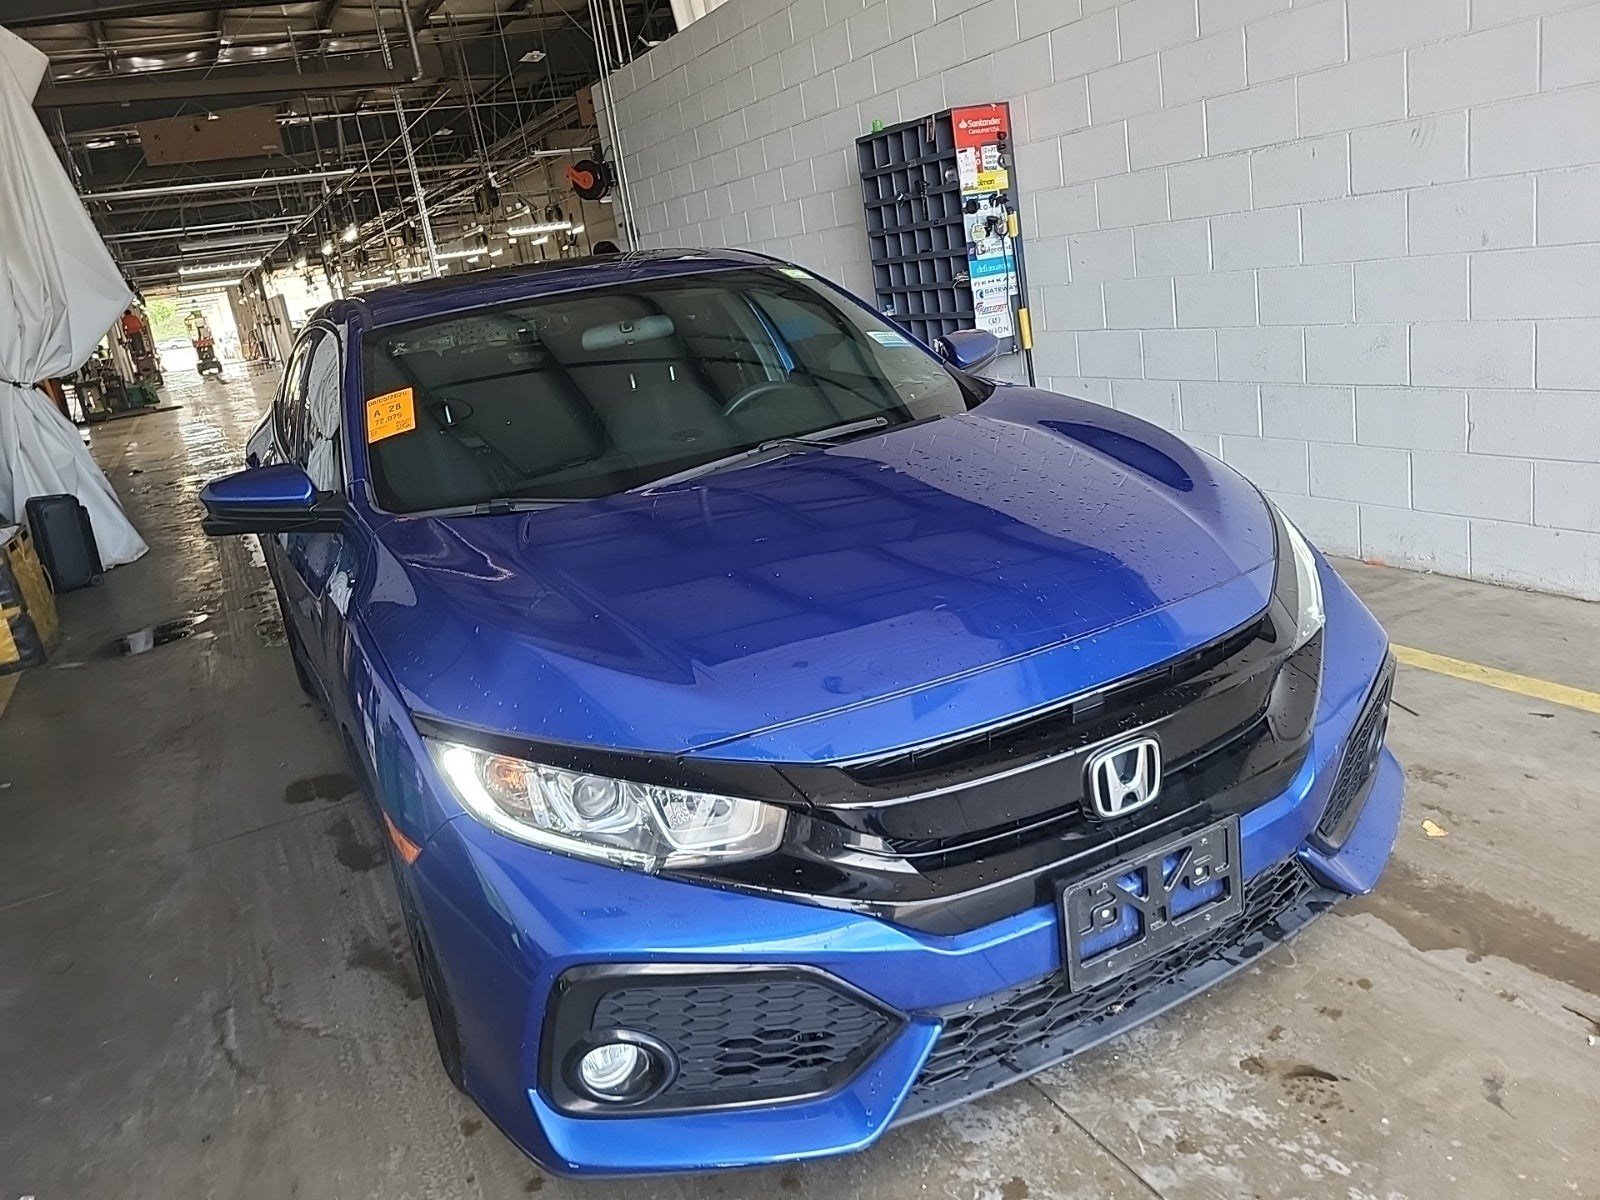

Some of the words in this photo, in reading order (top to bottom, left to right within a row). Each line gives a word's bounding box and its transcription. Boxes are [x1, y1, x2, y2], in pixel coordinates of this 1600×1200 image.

[967, 117, 1001, 128] Santander
[985, 285, 1018, 294] GATEWAY
[989, 326, 1009, 335] NION
[388, 403, 402, 412] 28
